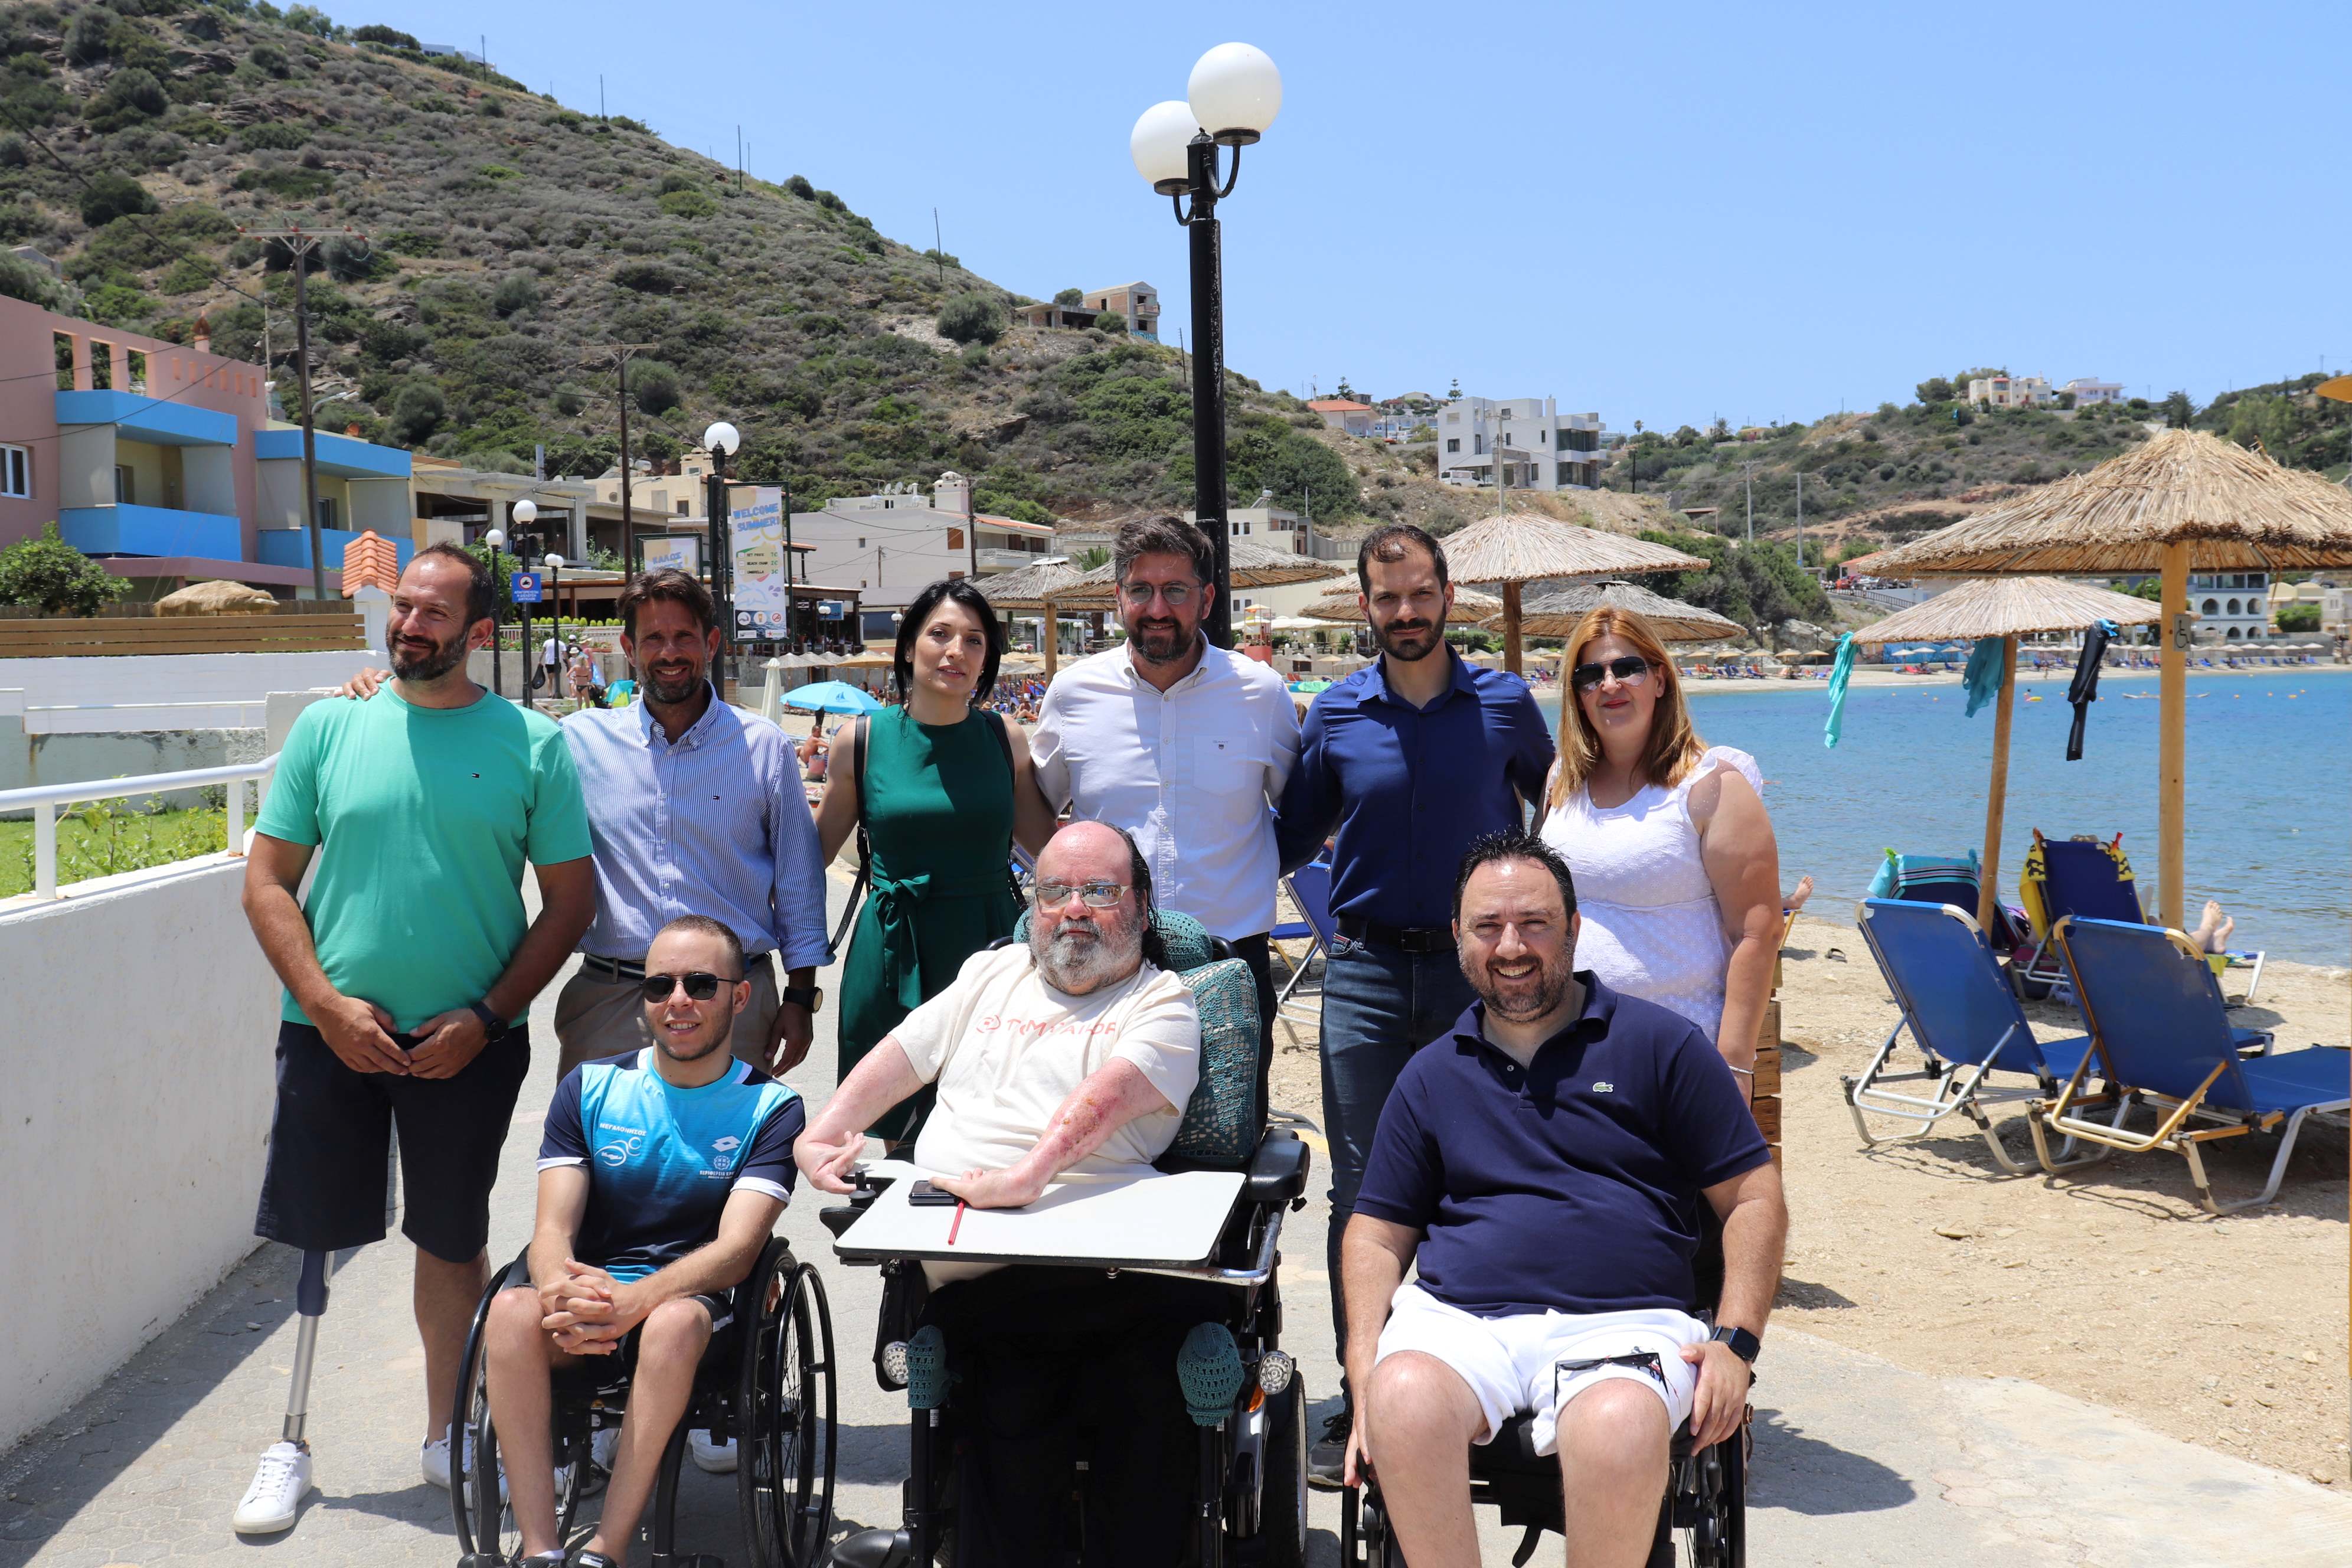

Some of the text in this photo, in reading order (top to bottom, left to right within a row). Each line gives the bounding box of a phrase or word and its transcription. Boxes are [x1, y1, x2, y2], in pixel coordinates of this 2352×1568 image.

[733, 502, 779, 520] WELCOME
[737, 515, 780, 532] SUMMER!
[599, 1123, 647, 1136] ΜΕΓΑΛΟΝΗΣΟΣ
